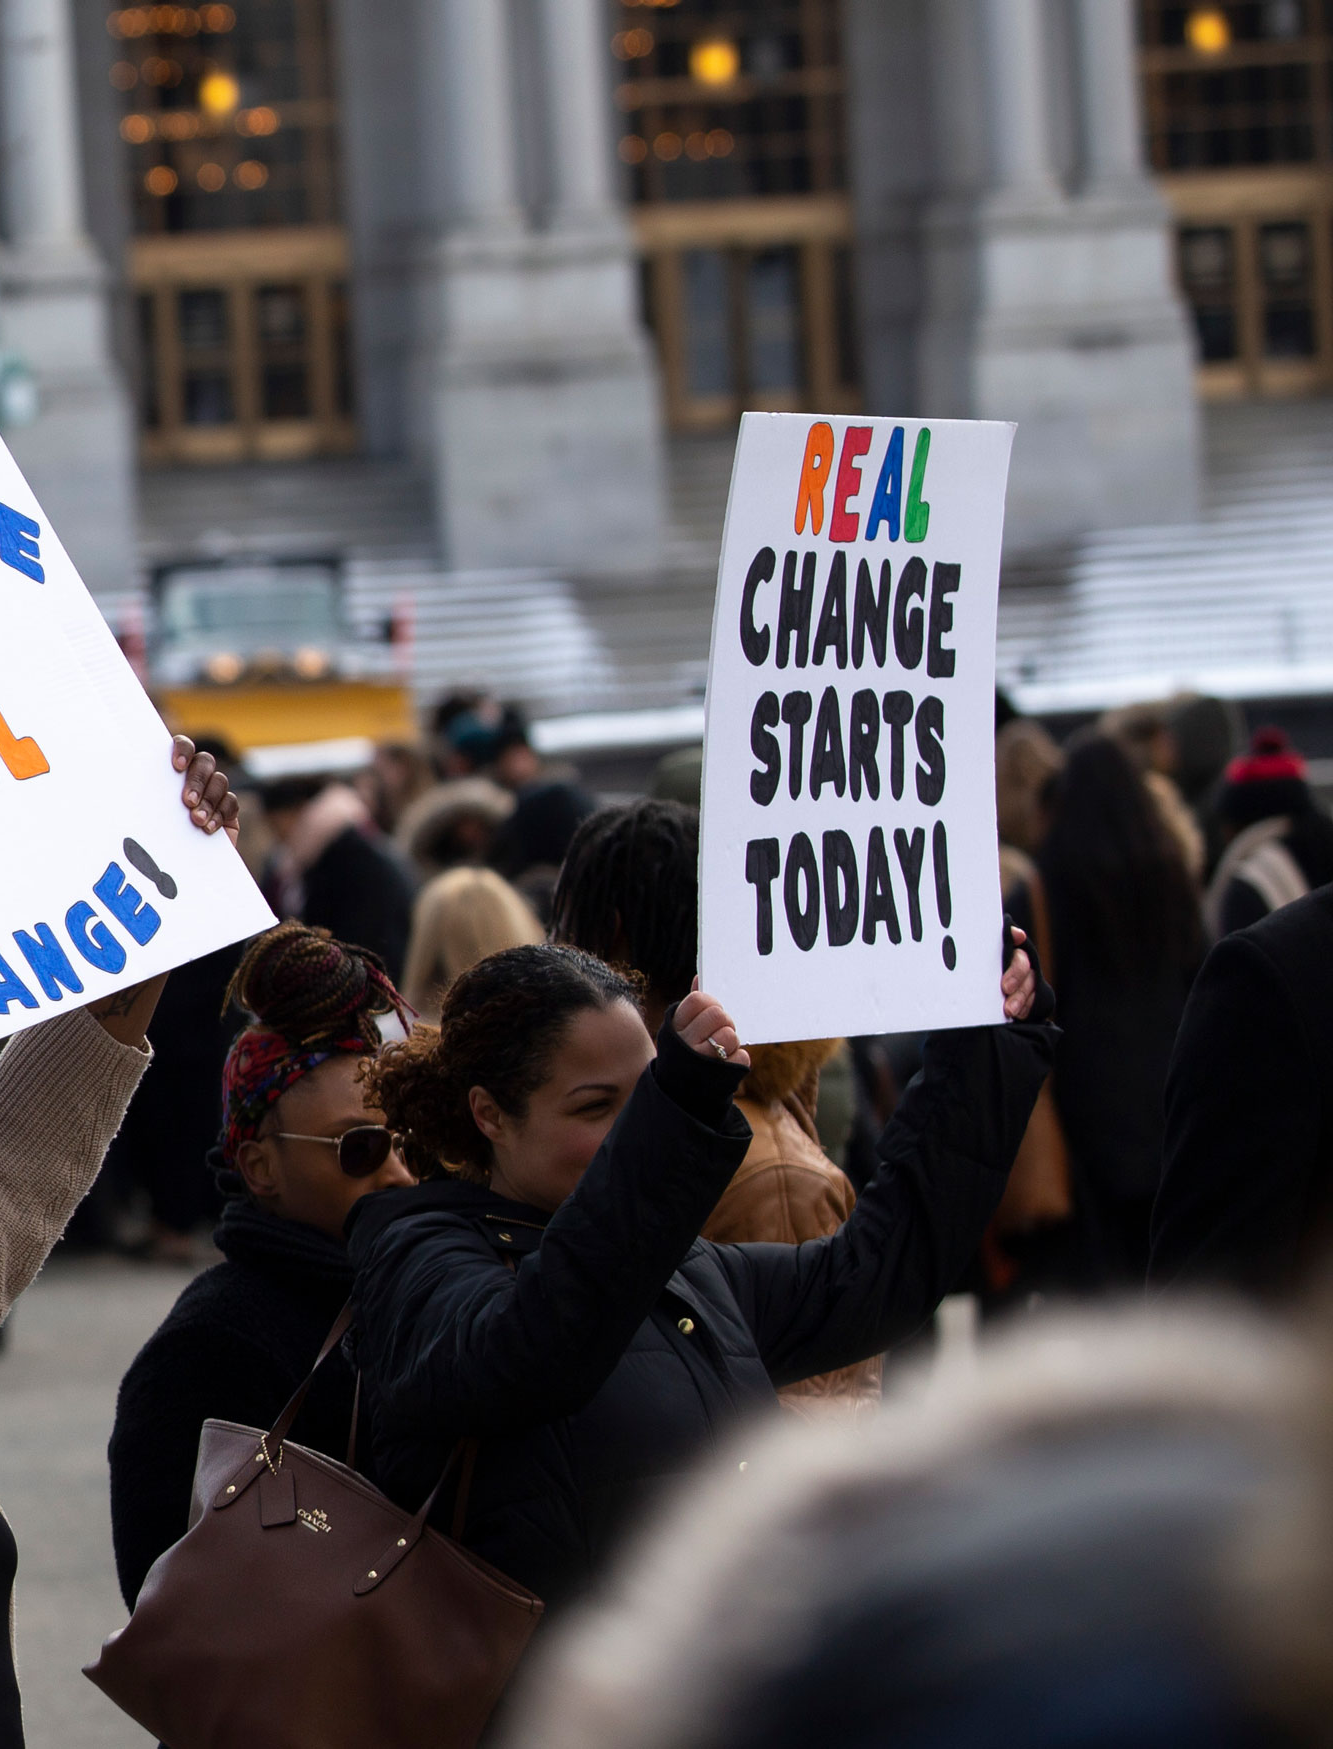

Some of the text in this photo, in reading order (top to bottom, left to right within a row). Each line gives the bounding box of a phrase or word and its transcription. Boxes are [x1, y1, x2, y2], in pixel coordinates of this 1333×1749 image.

[794, 421, 931, 543] REAL
[739, 546, 962, 679] CHANGE
[749, 685, 947, 807] STARTS
[745, 819, 957, 971] TODAY!
[297, 1508, 332, 1533] COACH
